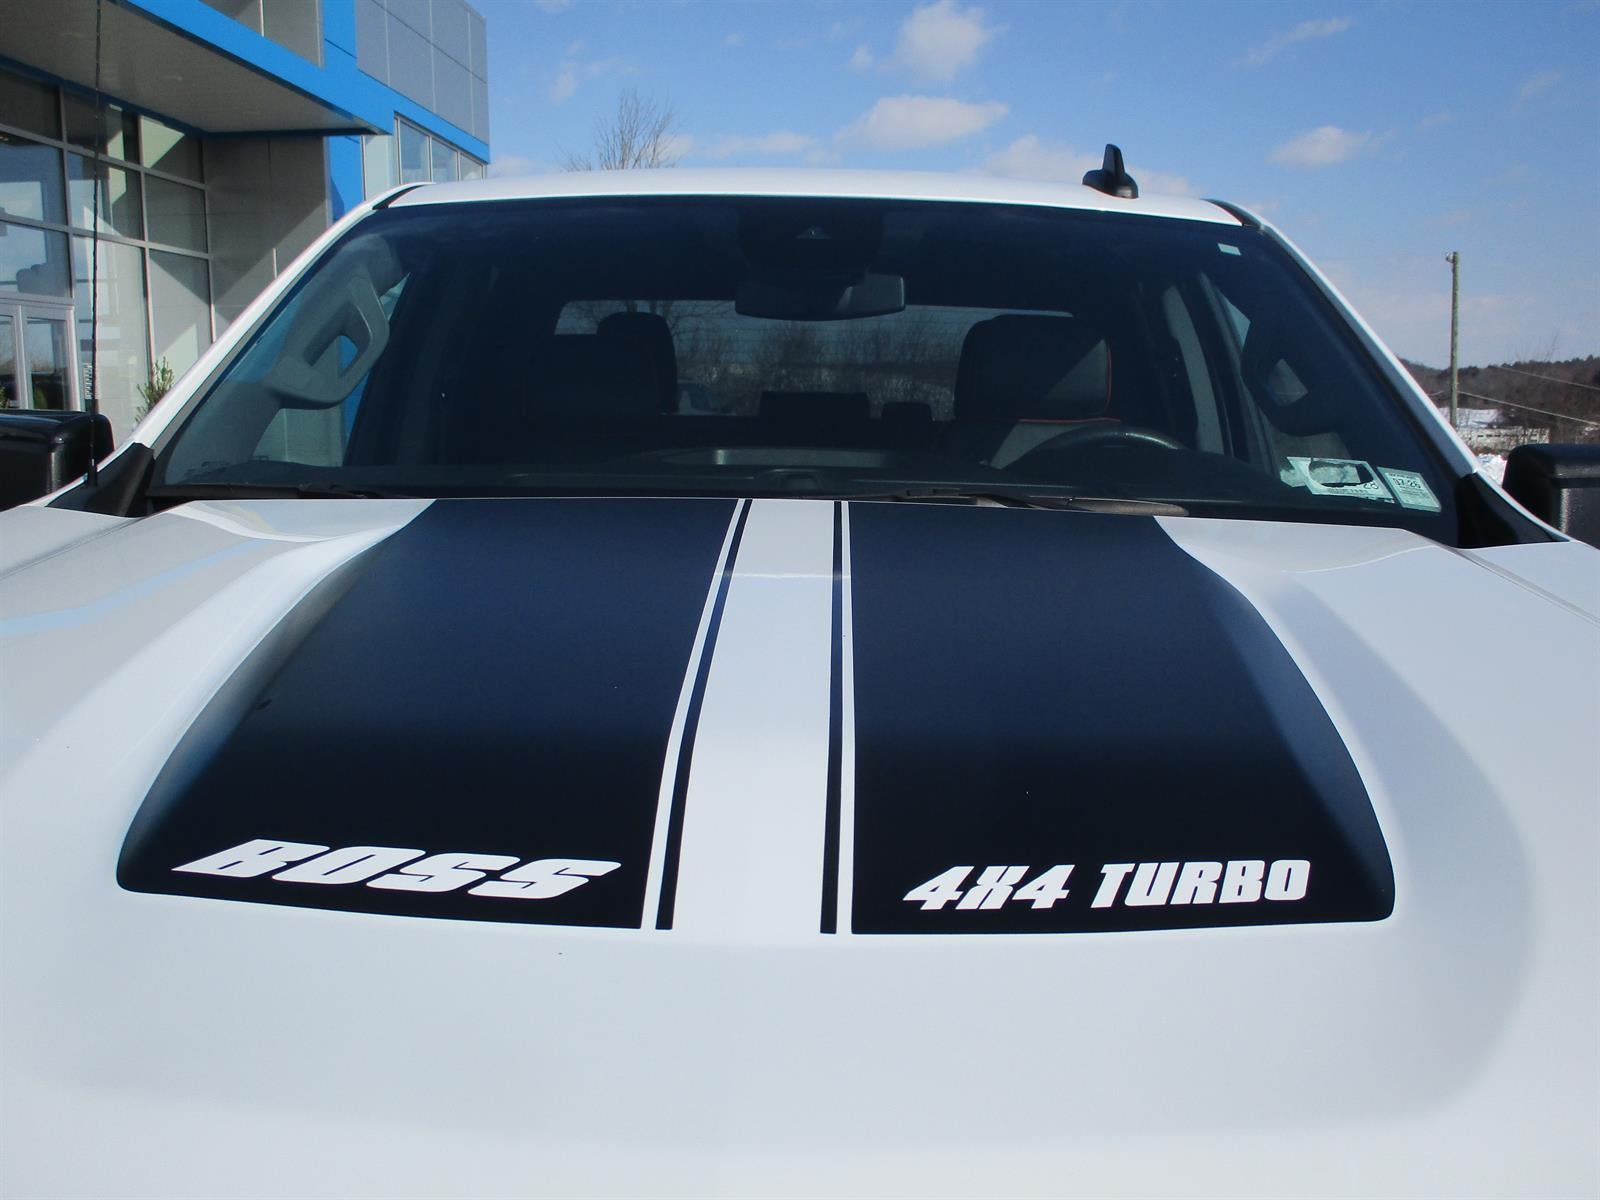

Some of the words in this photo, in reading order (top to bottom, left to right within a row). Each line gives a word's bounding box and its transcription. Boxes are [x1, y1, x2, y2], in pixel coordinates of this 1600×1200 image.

[171, 838, 622, 899] BOSS
[902, 864, 1076, 910] 4X4
[1090, 859, 1311, 908] TURBO
